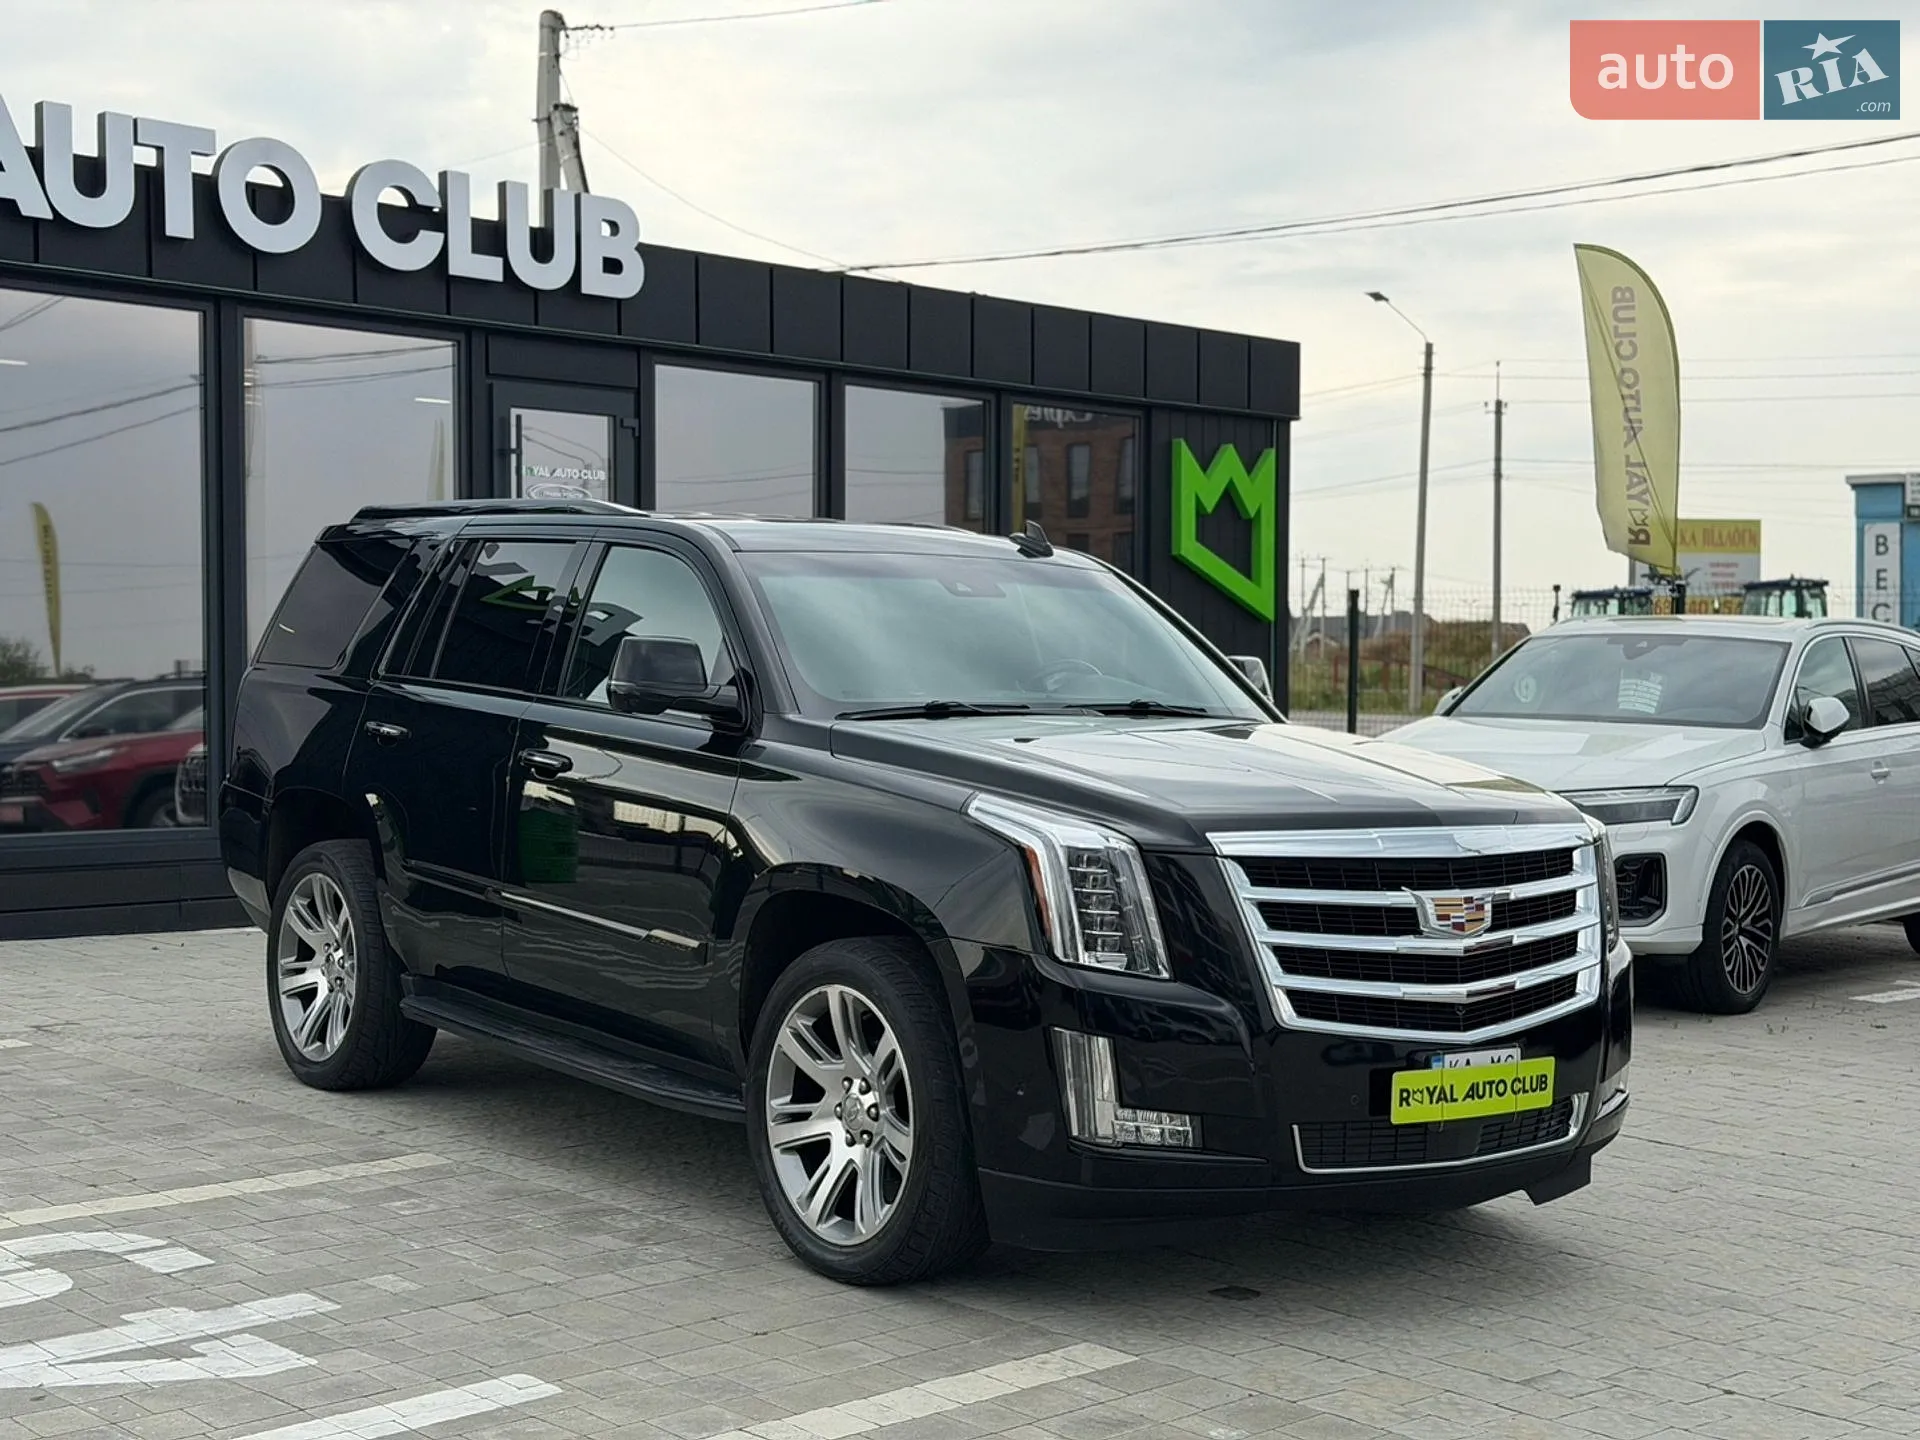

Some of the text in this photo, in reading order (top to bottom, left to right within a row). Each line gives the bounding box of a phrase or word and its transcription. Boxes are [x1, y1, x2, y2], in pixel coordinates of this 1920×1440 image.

[347, 158, 645, 299] CLUB
[551, 467, 579, 479] AUTO
[581, 469, 606, 480] CLUB
[1462, 1078, 1508, 1101] AUTO
[1510, 1073, 1549, 1096] CLUB
